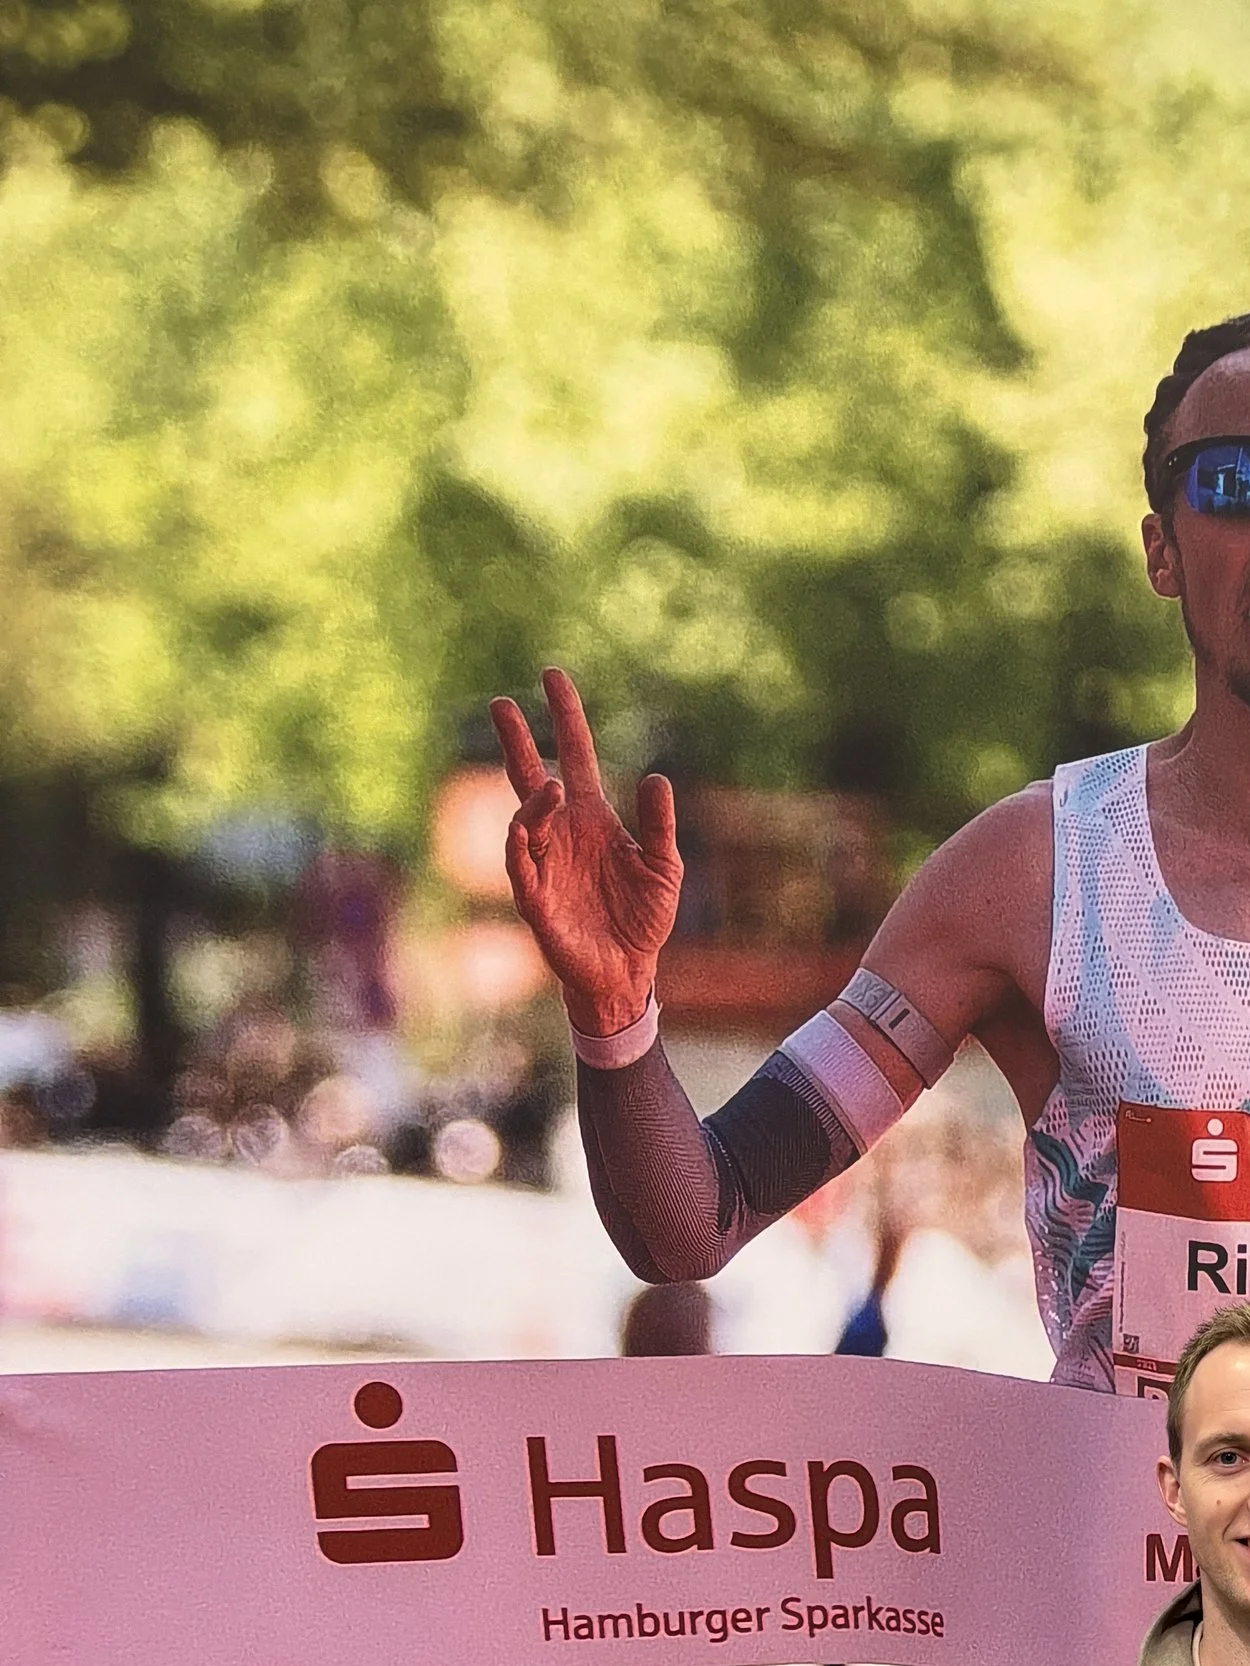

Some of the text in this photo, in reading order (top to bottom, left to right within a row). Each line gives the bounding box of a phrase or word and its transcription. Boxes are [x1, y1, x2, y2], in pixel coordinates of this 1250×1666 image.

[526, 1435, 942, 1579] Haspa
[542, 1596, 945, 1643] Hamburger Sparkasse
